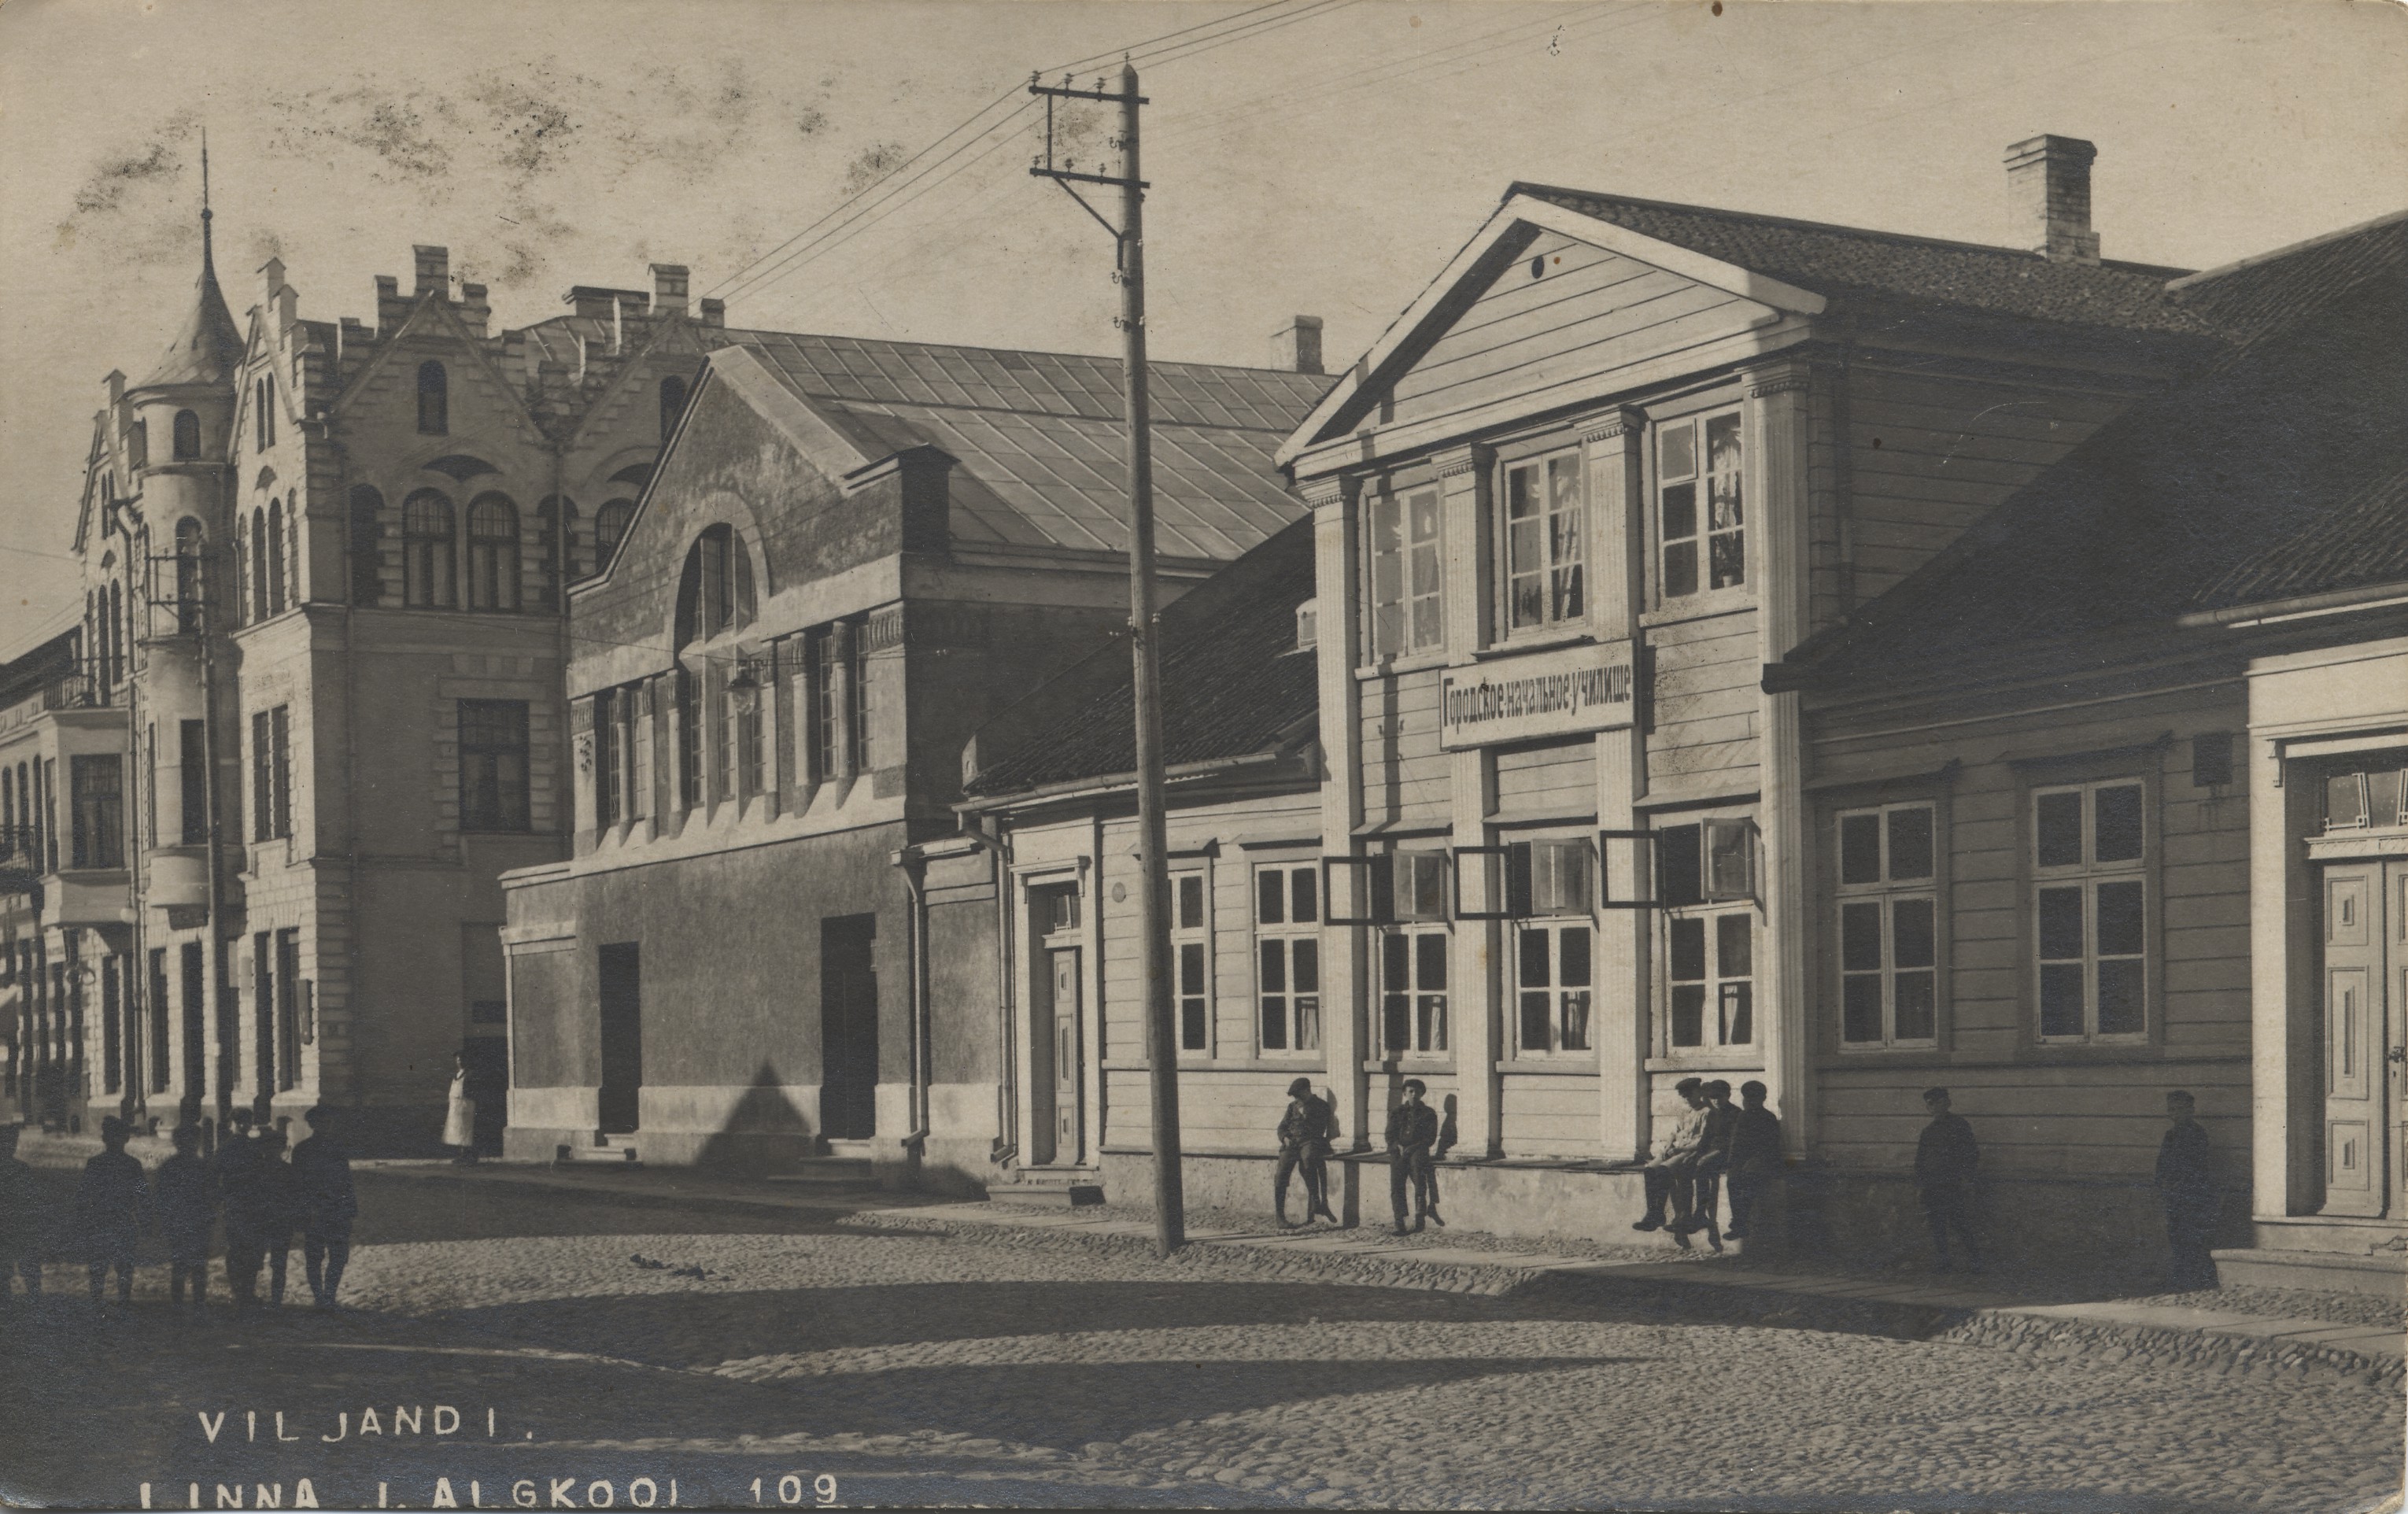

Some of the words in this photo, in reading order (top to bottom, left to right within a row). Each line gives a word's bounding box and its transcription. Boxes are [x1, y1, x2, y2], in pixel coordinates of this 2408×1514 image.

[1443, 678, 1504, 734] Городское
[1506, 673, 1569, 718] начальное
[1571, 664, 1631, 716] училище
